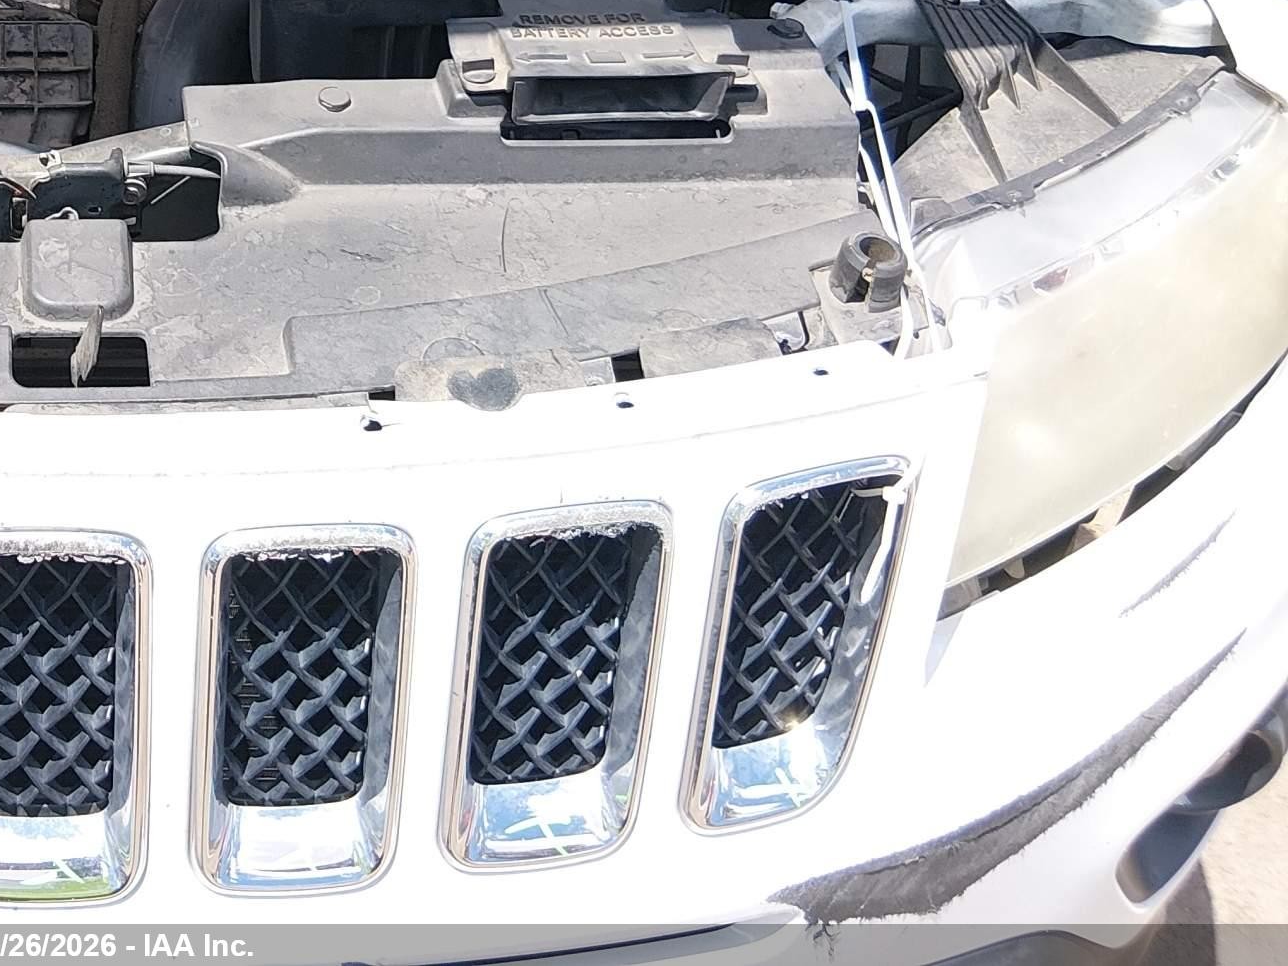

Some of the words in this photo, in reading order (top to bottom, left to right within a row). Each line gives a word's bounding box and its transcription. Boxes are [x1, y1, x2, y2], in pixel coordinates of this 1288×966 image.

[518, 13, 601, 26] REMOVE
[603, 12, 646, 24] FOR
[510, 26, 591, 39] BATTERY
[598, 24, 674, 38] ACCESS
